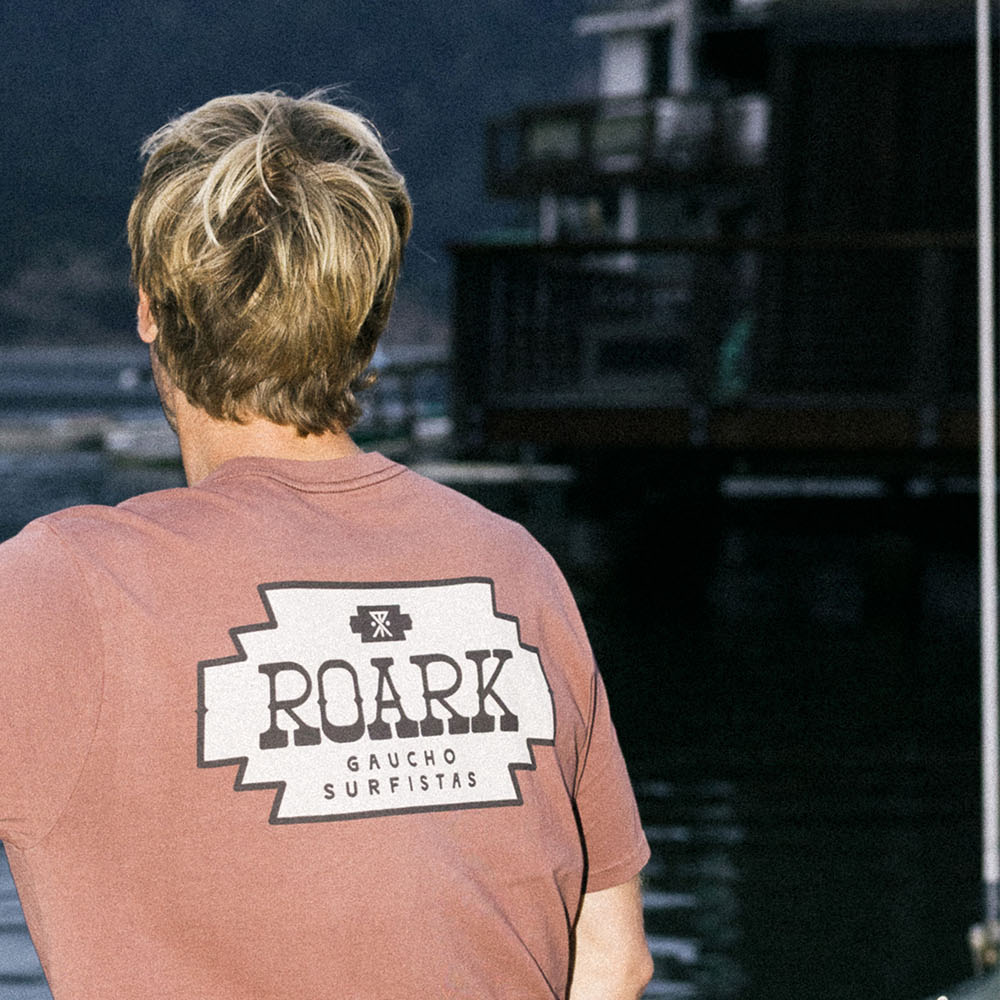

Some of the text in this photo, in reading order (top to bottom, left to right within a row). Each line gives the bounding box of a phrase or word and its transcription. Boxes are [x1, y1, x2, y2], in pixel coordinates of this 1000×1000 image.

[258, 649, 519, 750] ROARK
[346, 748, 456, 772] GAUCHO
[323, 771, 477, 800] SURFISTAS
